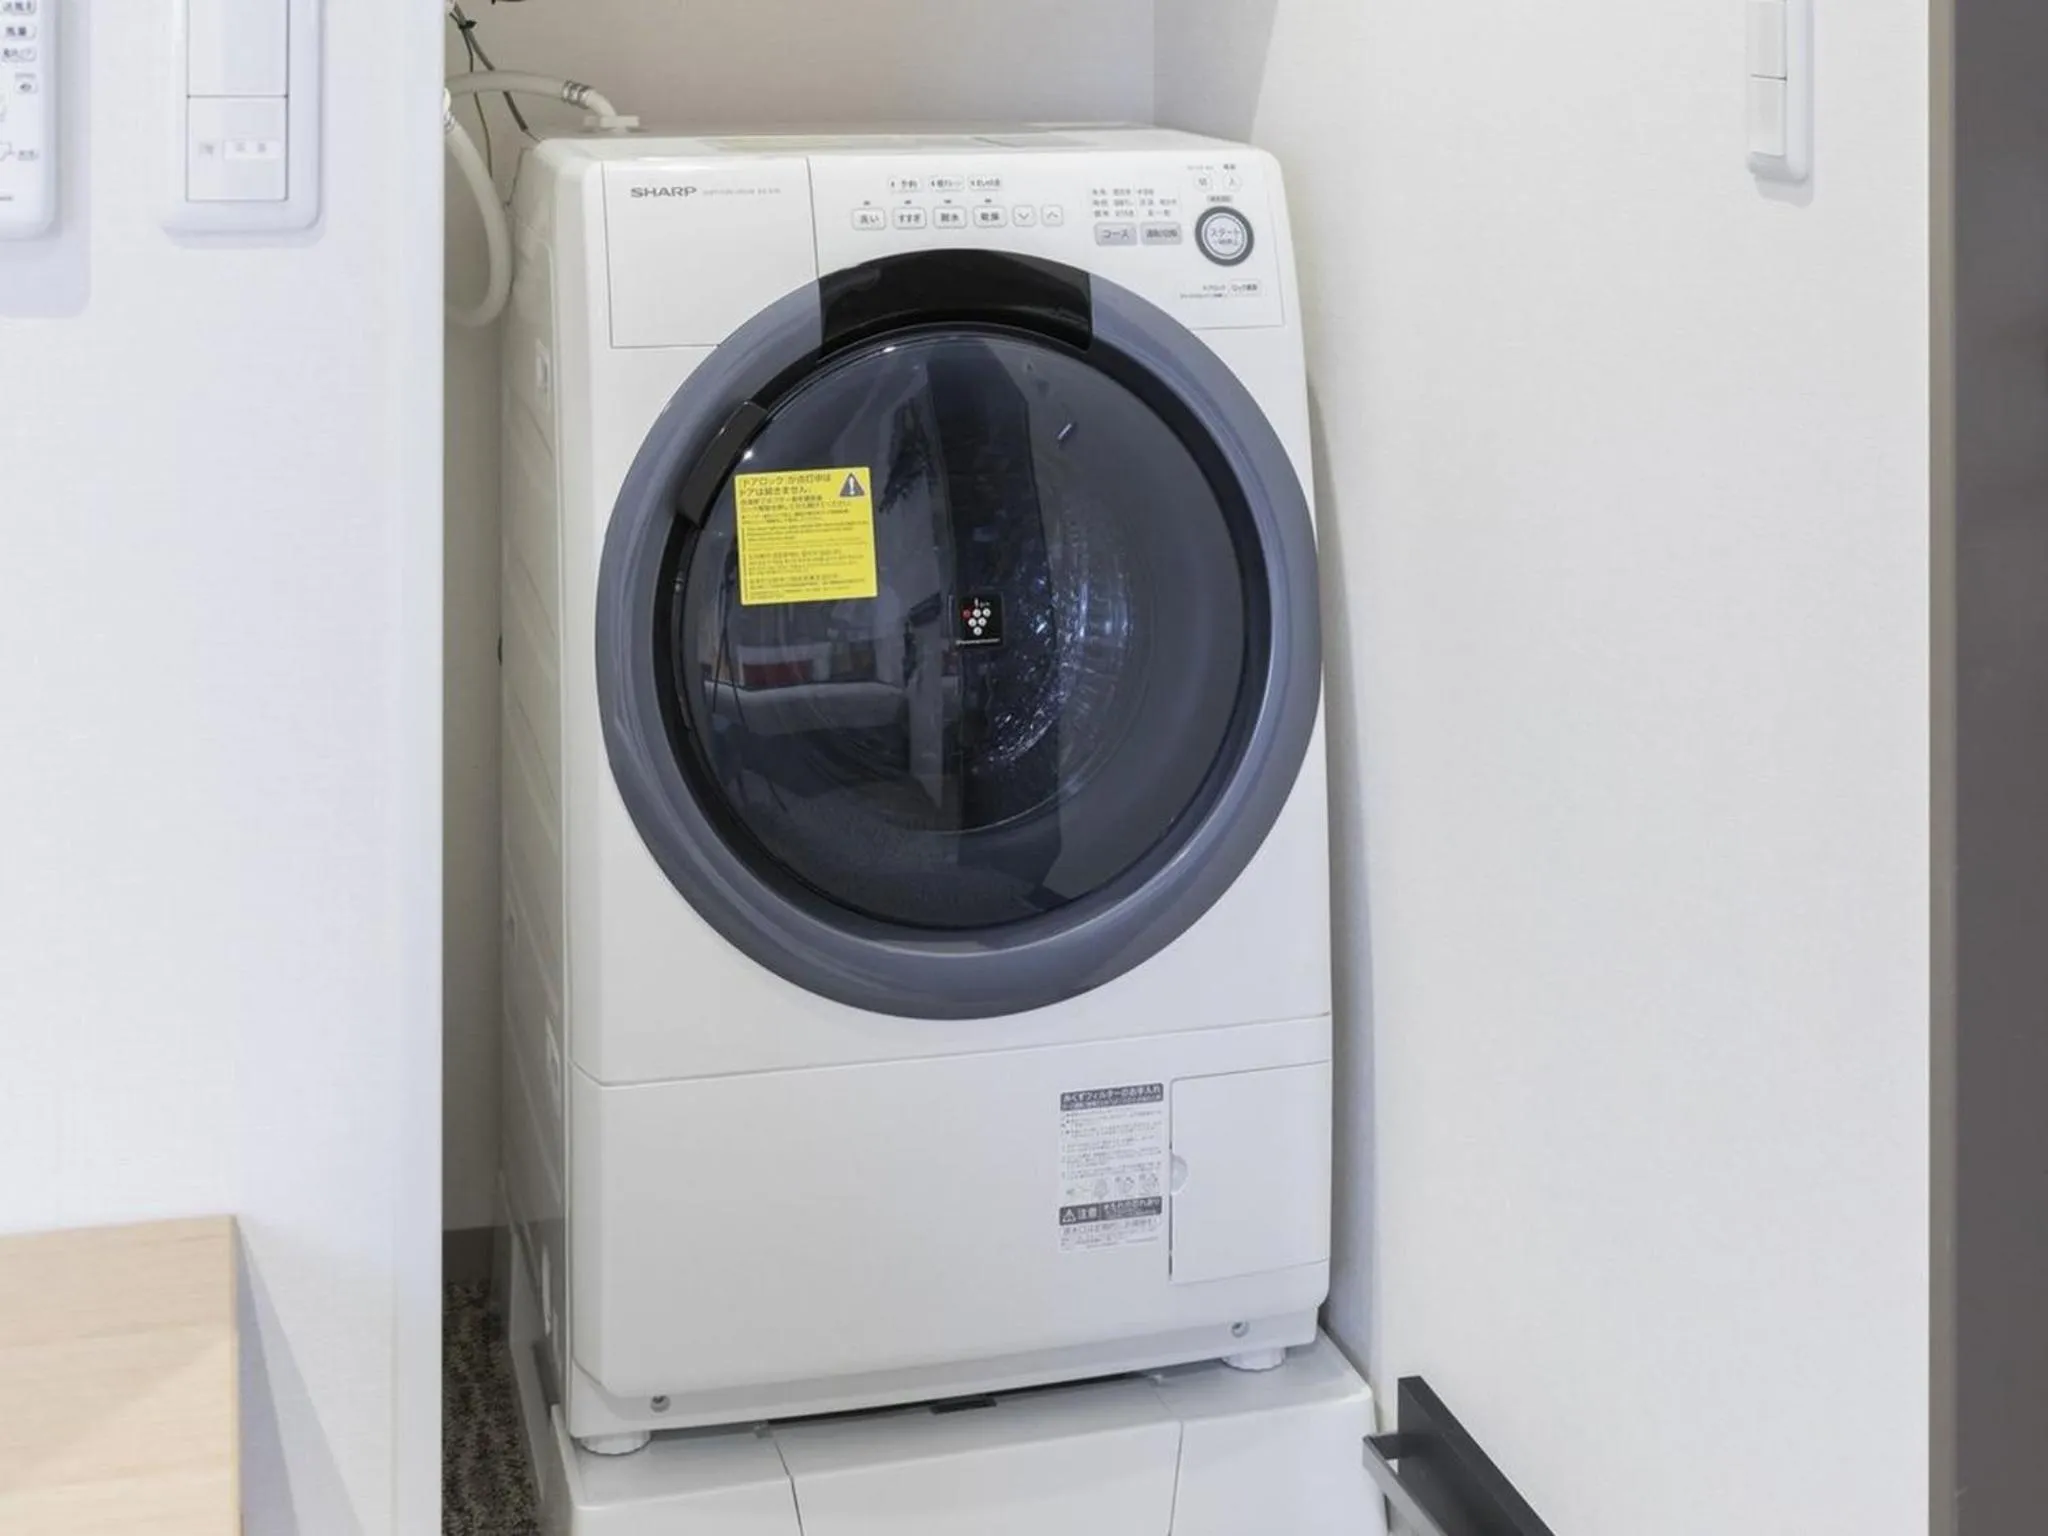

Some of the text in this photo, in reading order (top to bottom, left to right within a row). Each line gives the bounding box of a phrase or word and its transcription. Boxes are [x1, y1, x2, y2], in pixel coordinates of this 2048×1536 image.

[630, 186, 697, 198] SHARP
[1102, 229, 1130, 240] コース
